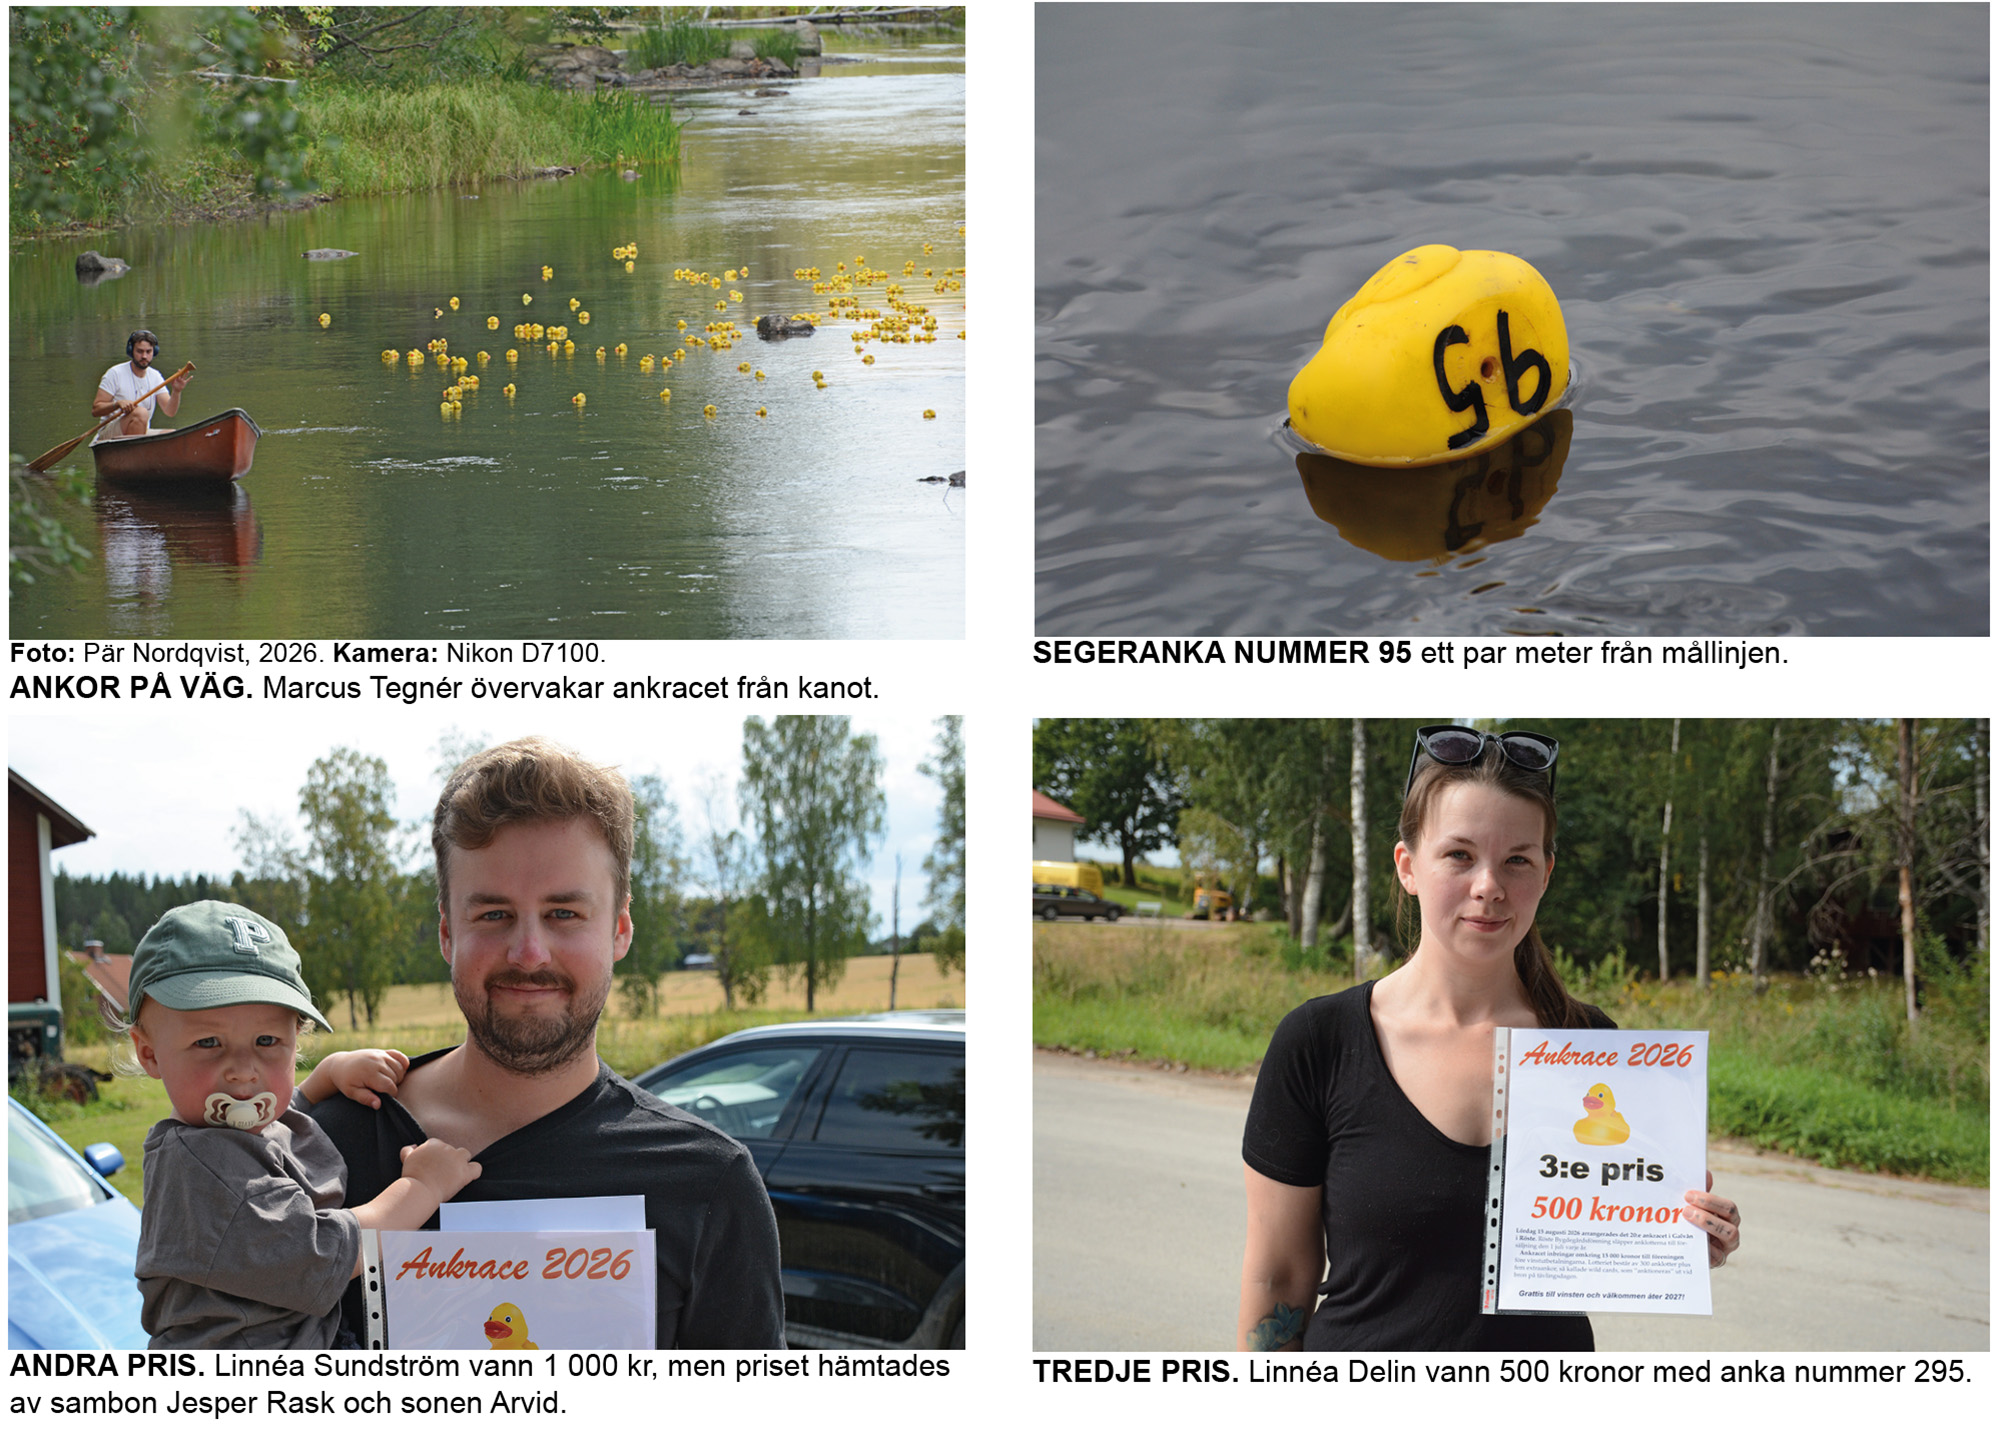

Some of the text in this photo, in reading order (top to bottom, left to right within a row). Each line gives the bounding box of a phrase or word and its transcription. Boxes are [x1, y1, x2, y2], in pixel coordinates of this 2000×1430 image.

[1433, 309, 1552, 450] 95
[225, 916, 270, 956] P
[1519, 1040, 1695, 1068] Ankrace 2026
[1539, 1154, 1665, 1186] 3:e pris
[1531, 1196, 1683, 1223] 500 kronor
[395, 1246, 634, 1280] Ankrace 2026
[1586, 1291, 1600, 1299] och
[1602, 1292, 1646, 1300] välkommen
[1664, 1293, 1685, 1301] 2027!
